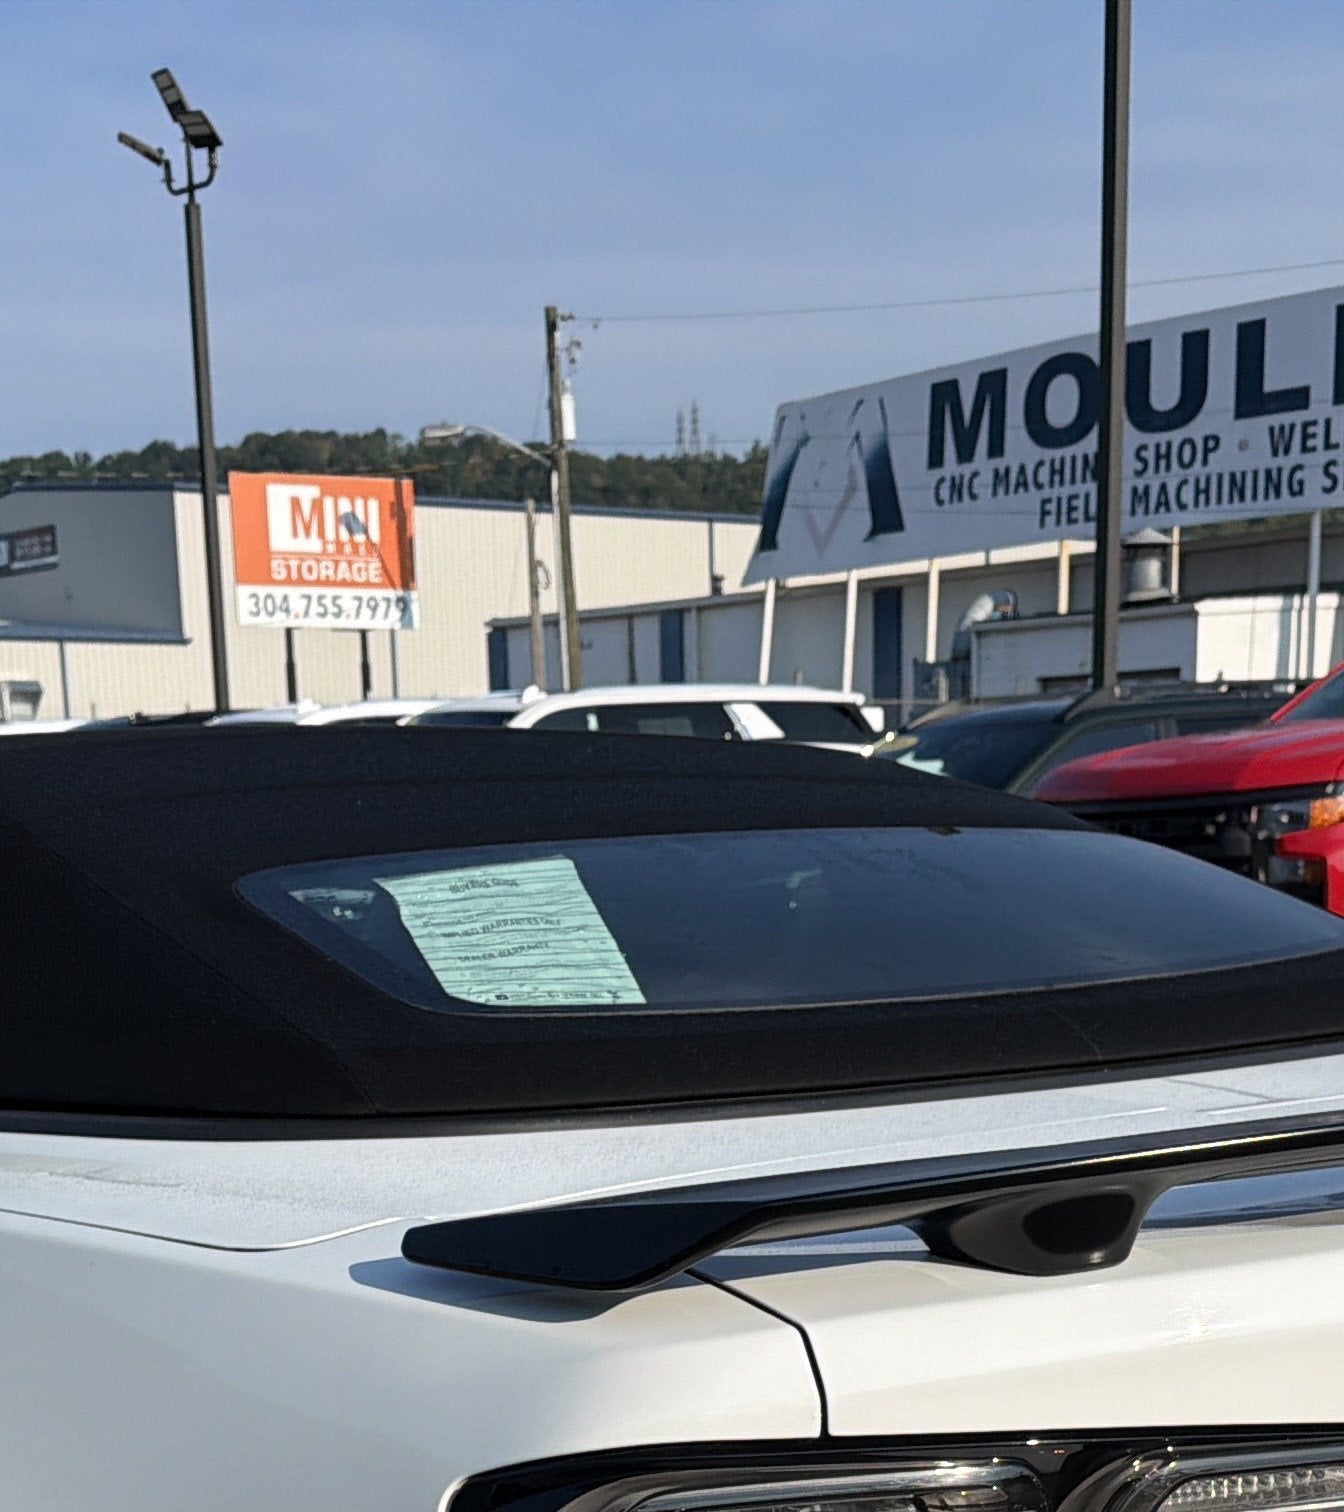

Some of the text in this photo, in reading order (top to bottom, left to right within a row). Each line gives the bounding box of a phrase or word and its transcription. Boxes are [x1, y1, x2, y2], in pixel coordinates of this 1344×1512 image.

[933, 472, 981, 507] CNC
[991, 451, 1098, 498] MACHIN
[1133, 434, 1221, 477] SHOP
[1038, 491, 1097, 530] FIEL
[1129, 464, 1306, 518] MACHINING
[266, 483, 381, 554] MINI
[270, 558, 383, 583] STORAGE
